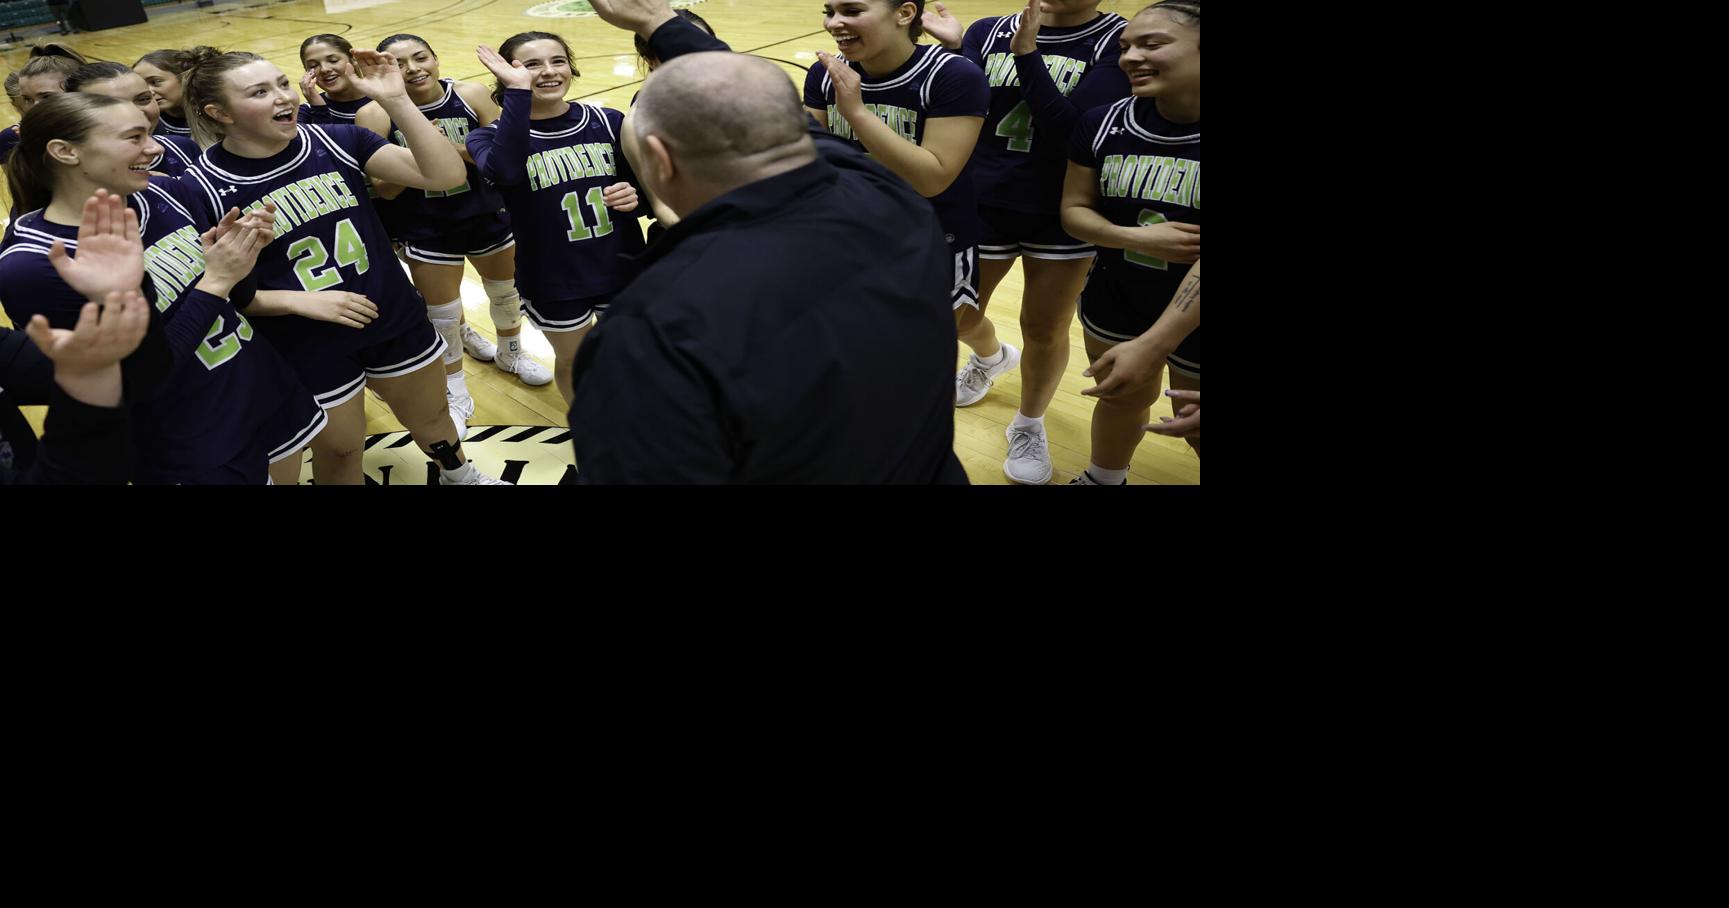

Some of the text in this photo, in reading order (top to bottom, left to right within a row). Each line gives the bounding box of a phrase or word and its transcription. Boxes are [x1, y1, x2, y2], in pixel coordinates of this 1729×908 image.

[995, 100, 1034, 152] 4
[526, 142, 617, 192] PROVIDENCE
[241, 171, 359, 240] OVIDENCE
[561, 186, 614, 242] 11
[286, 218, 369, 292] 24
